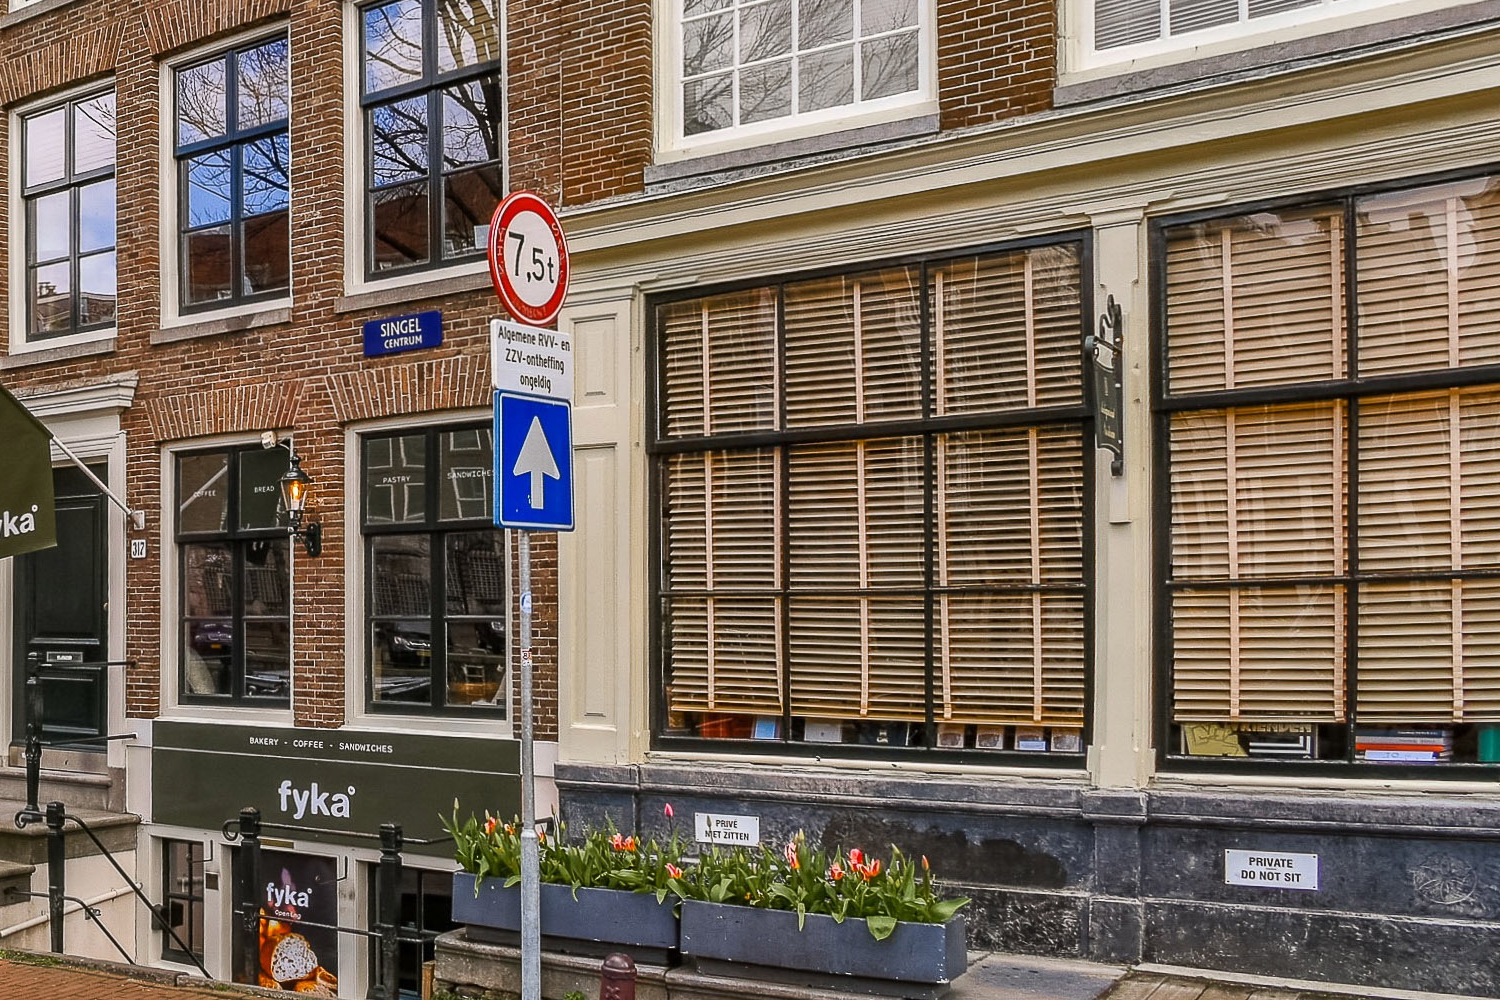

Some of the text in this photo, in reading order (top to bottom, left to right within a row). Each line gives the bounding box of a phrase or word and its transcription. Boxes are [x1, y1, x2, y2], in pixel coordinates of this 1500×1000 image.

[380, 317, 422, 337] SINGEL
[384, 334, 423, 349] CENTRUM
[498, 325, 571, 352] Algemene RVV- en
[505, 348, 564, 375] ZZV-ontheffing
[520, 374, 551, 394] ongeldig
[382, 475, 411, 484] PASTRY
[447, 469, 494, 479] SANDWICHE
[254, 485, 275, 493] BREAD
[132, 542, 145, 556] 317
[249, 737, 393, 754] BAKERY COFFEE SANDWICHES
[705, 830, 750, 841] NET ZITTEN
[1248, 857, 1293, 868] PRIVATE
[1241, 869, 1302, 883] DO NOT SIT
